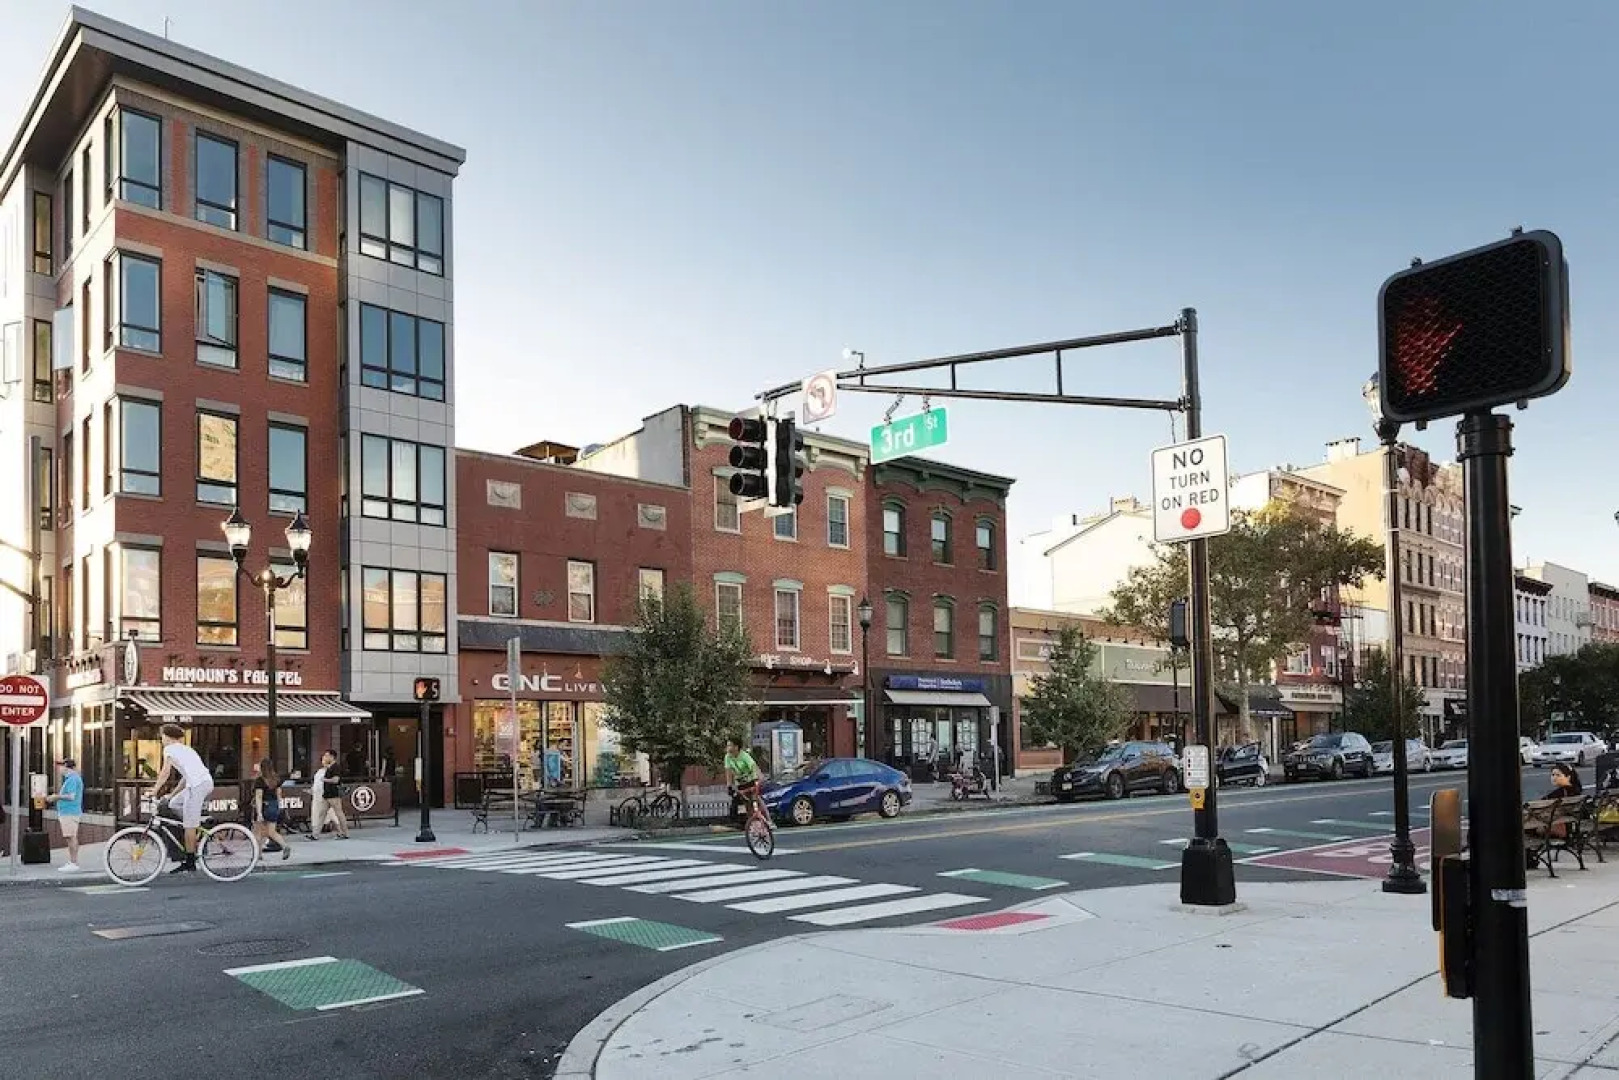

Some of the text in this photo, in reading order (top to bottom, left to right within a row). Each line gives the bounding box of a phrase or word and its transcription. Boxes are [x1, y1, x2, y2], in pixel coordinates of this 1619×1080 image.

[881, 415, 939, 454] 3rd St
[1173, 448, 1204, 470] NO
[1169, 470, 1210, 489] TURN
[1162, 488, 1220, 511] ON RED
[162, 666, 302, 686] MAMOUN'S FALFEL
[491, 673, 562, 692] GNC
[565, 682, 598, 693] LIVE
[19, 684, 40, 694] NOT
[431, 682, 438, 698] 5
[1, 705, 35, 716] ENTER
